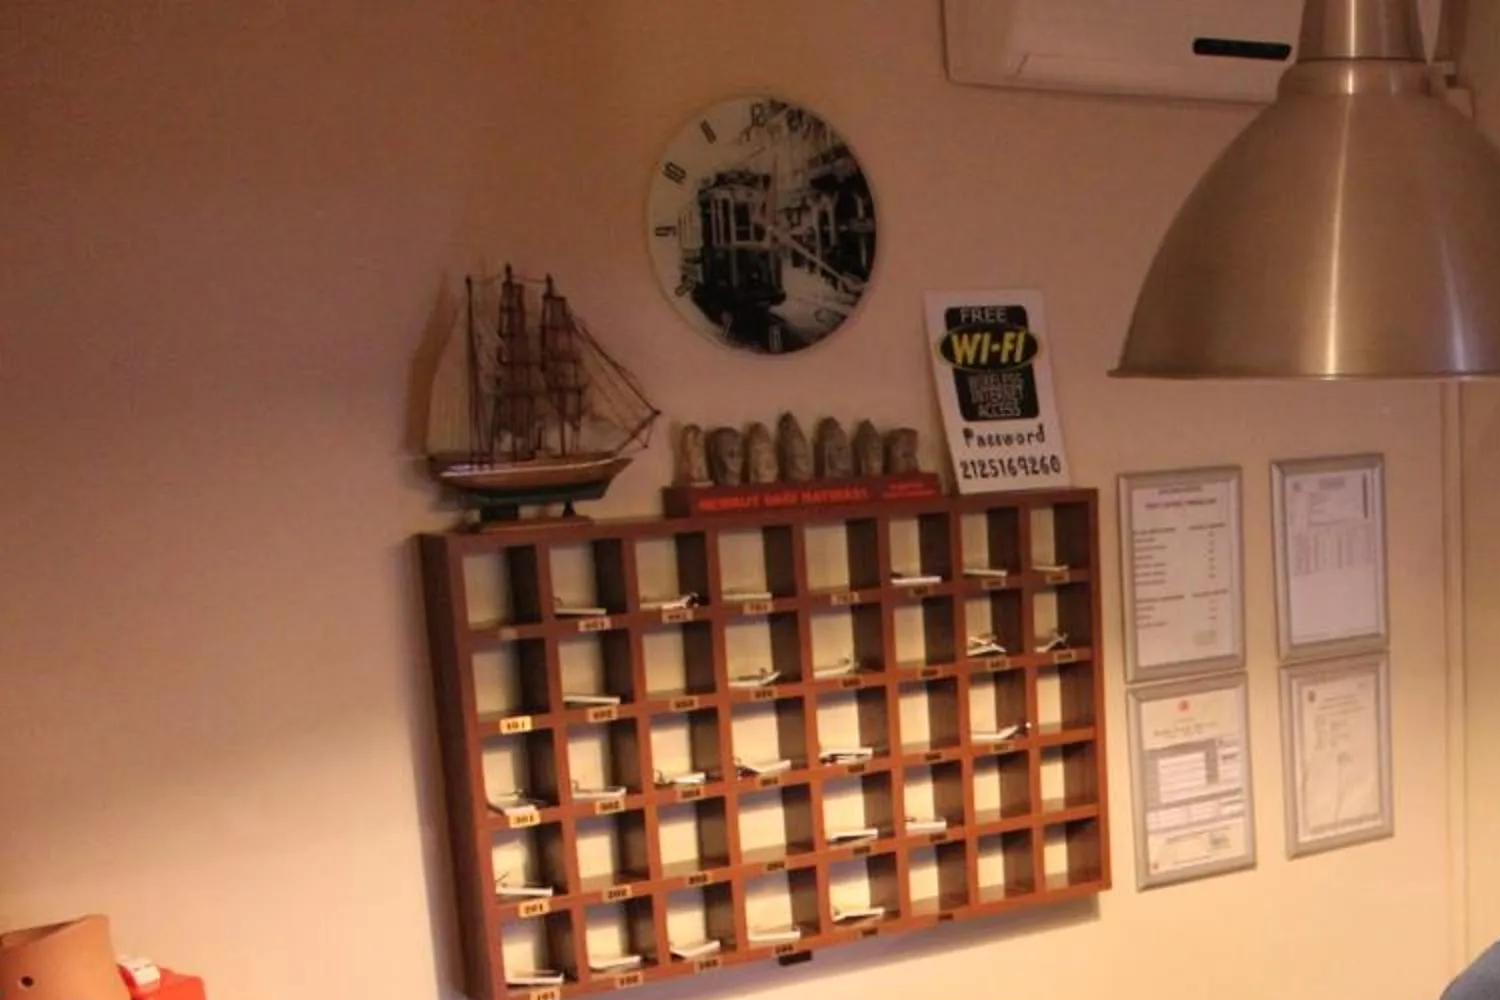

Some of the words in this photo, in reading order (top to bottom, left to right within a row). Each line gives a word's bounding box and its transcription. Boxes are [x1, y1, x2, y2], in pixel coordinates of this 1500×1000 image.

[960, 308, 1008, 323] FREE
[952, 329, 1026, 365] WI-FI
[962, 423, 1045, 448] Password
[959, 455, 1062, 480] 2125169260
